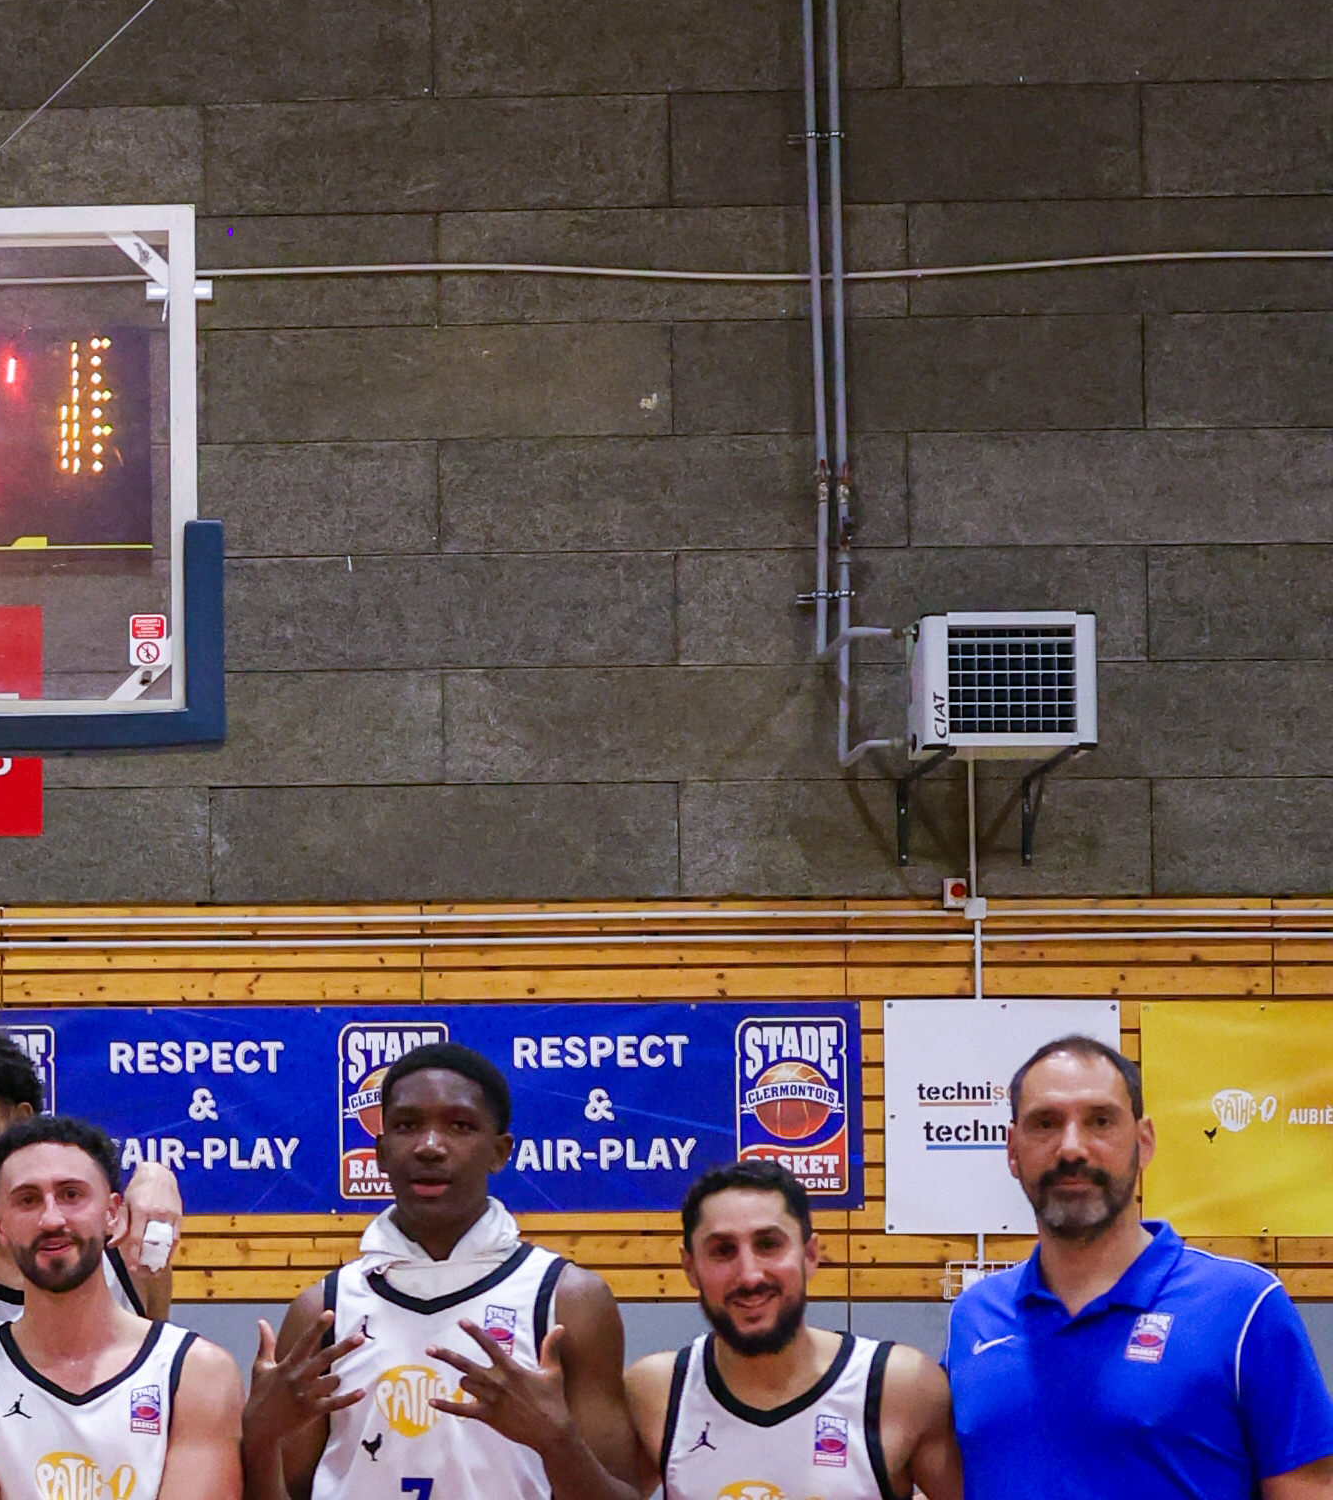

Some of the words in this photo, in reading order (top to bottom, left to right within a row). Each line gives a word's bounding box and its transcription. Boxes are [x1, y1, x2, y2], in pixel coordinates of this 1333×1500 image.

[933, 692, 948, 739] CIAT
[109, 1041, 284, 1074] RESPECT
[513, 1035, 689, 1069] RESPECT
[745, 1026, 838, 1079] STADE
[188, 1087, 219, 1121] &
[584, 1087, 615, 1122] &
[747, 1084, 836, 1105] CLERMONTOIS
[111, 1137, 300, 1170] AIR-PLAY
[510, 1137, 697, 1172] AIR-PLAY
